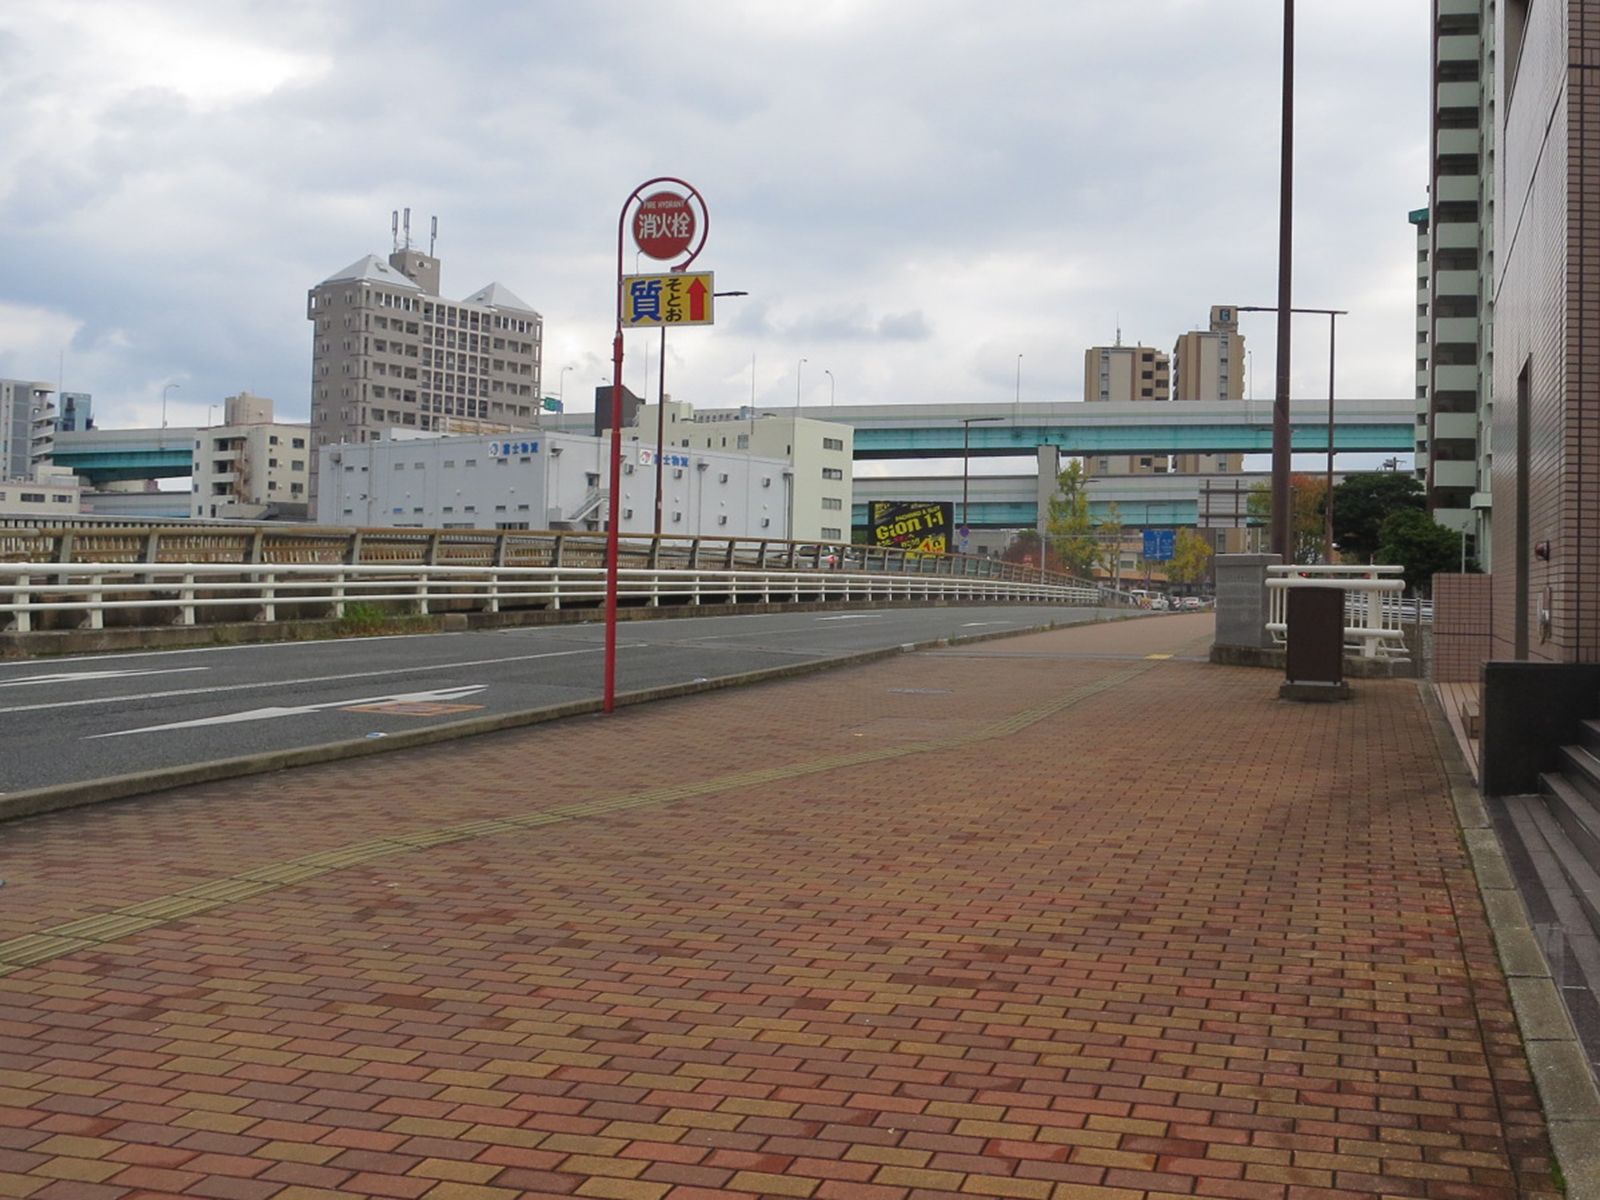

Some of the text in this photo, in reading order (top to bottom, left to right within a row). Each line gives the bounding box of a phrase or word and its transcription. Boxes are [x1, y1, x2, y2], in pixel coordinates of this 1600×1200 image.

[638, 212, 690, 239] 消火栓
[630, 280, 662, 323] 質
[665, 278, 682, 322] そとお
